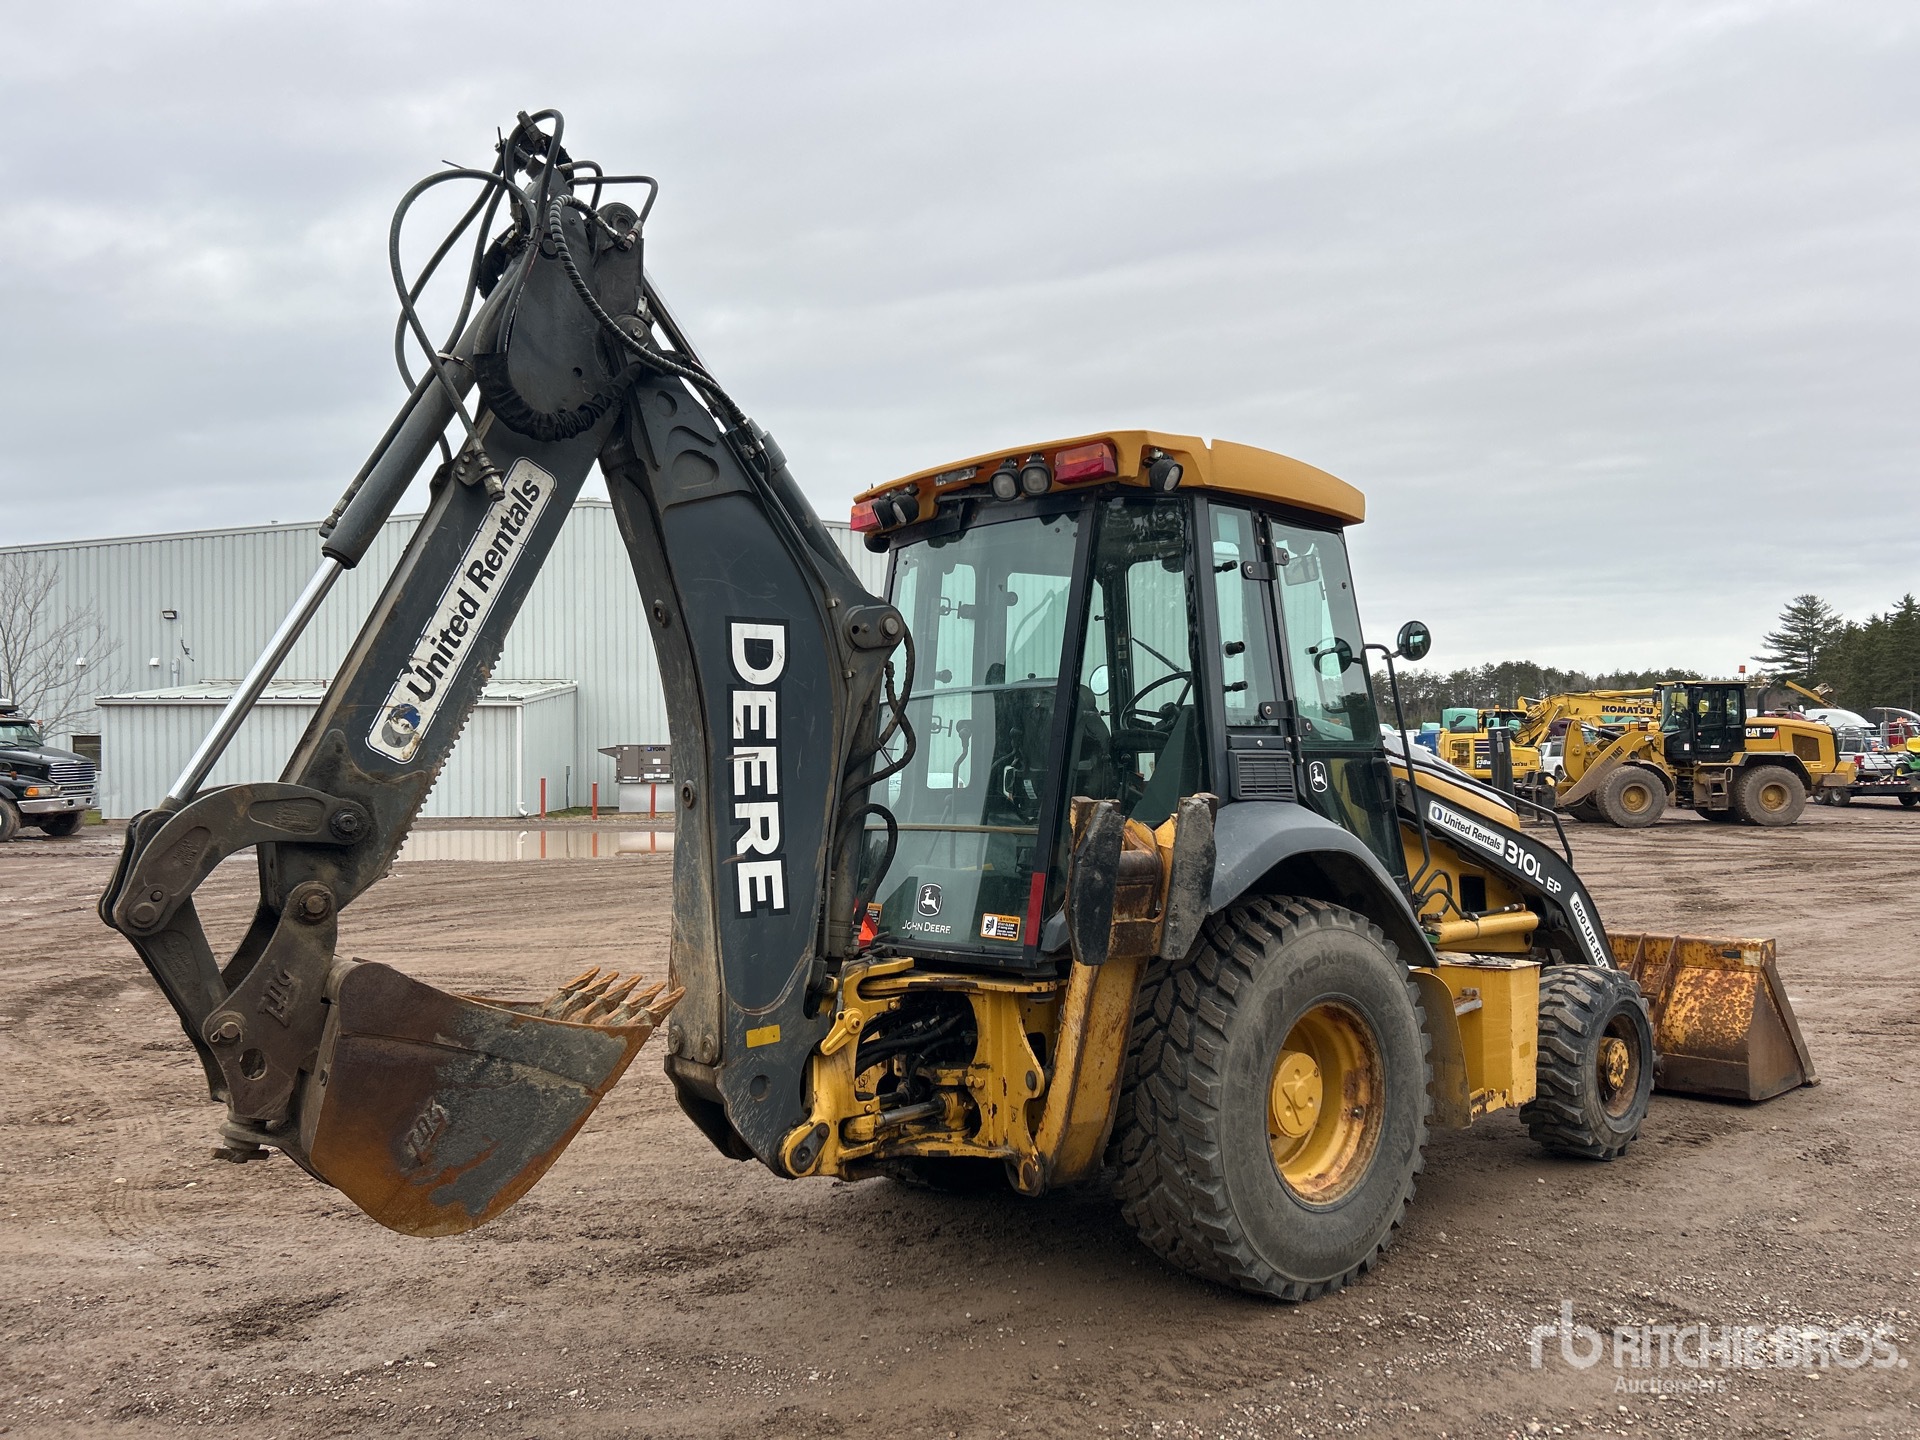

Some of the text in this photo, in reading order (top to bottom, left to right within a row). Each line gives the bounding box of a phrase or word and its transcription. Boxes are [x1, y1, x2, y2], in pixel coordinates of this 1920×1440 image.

[406, 478, 541, 702] United Rentals
[1602, 705, 1654, 715] KOMATSU
[1745, 728, 1760, 738] CAT
[731, 622, 786, 913] DEERE
[1443, 812, 1502, 850] United Rentals
[1505, 840, 1562, 894] 310L EP
[902, 920, 952, 935] JOHN DEERE
